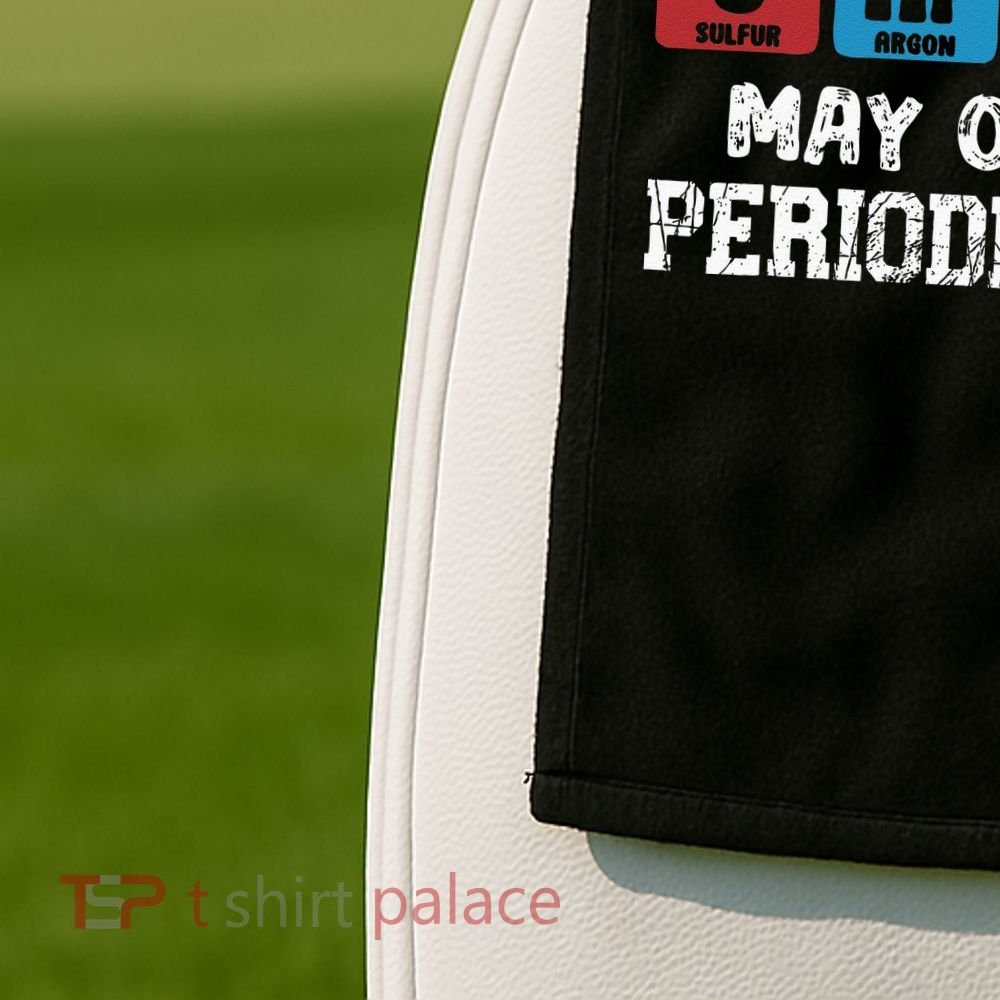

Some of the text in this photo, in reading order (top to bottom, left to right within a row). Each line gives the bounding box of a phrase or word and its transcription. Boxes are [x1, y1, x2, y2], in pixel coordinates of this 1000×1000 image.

[695, 21, 781, 48] SULFUR
[874, 31, 956, 57] ARGON
[727, 82, 924, 172] MAY
